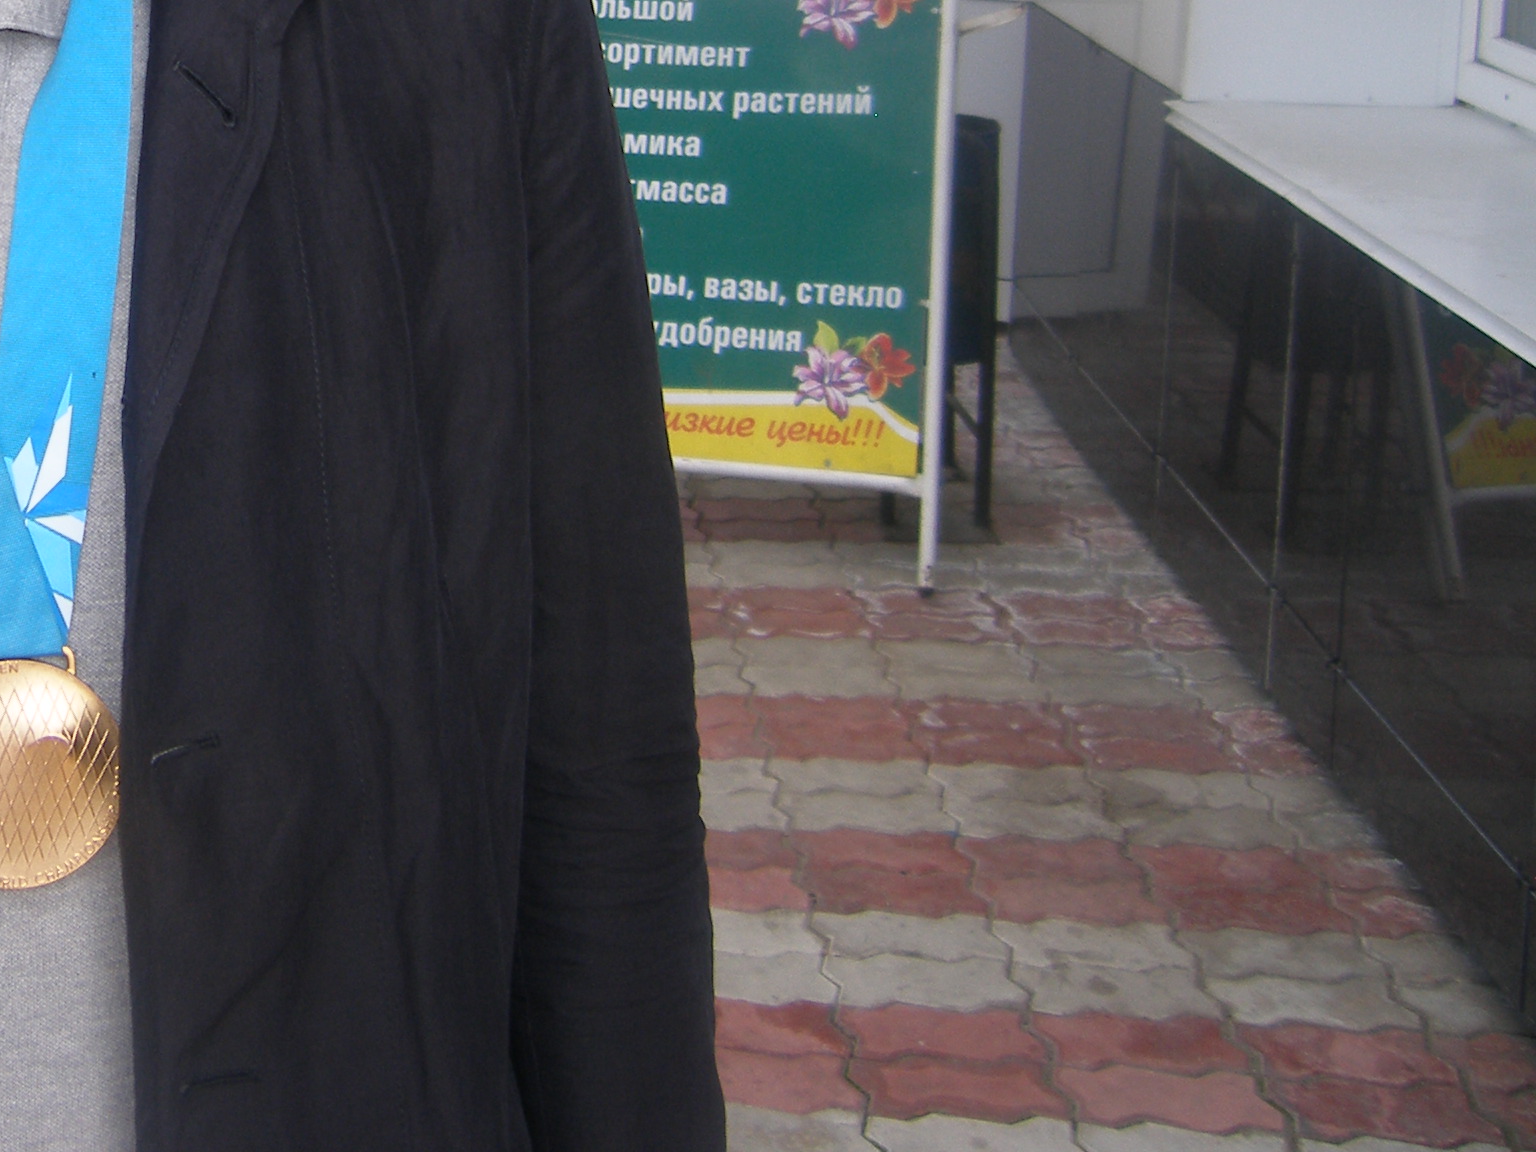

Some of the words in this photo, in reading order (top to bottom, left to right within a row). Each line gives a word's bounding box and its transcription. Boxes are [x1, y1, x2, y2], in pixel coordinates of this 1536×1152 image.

[609, 86, 724, 112] шечных
[732, 85, 873, 119] растений
[623, 133, 701, 157] мика
[704, 277, 787, 306] вазы,
[796, 281, 904, 309] стекло
[767, 418, 887, 448] цены!!!
